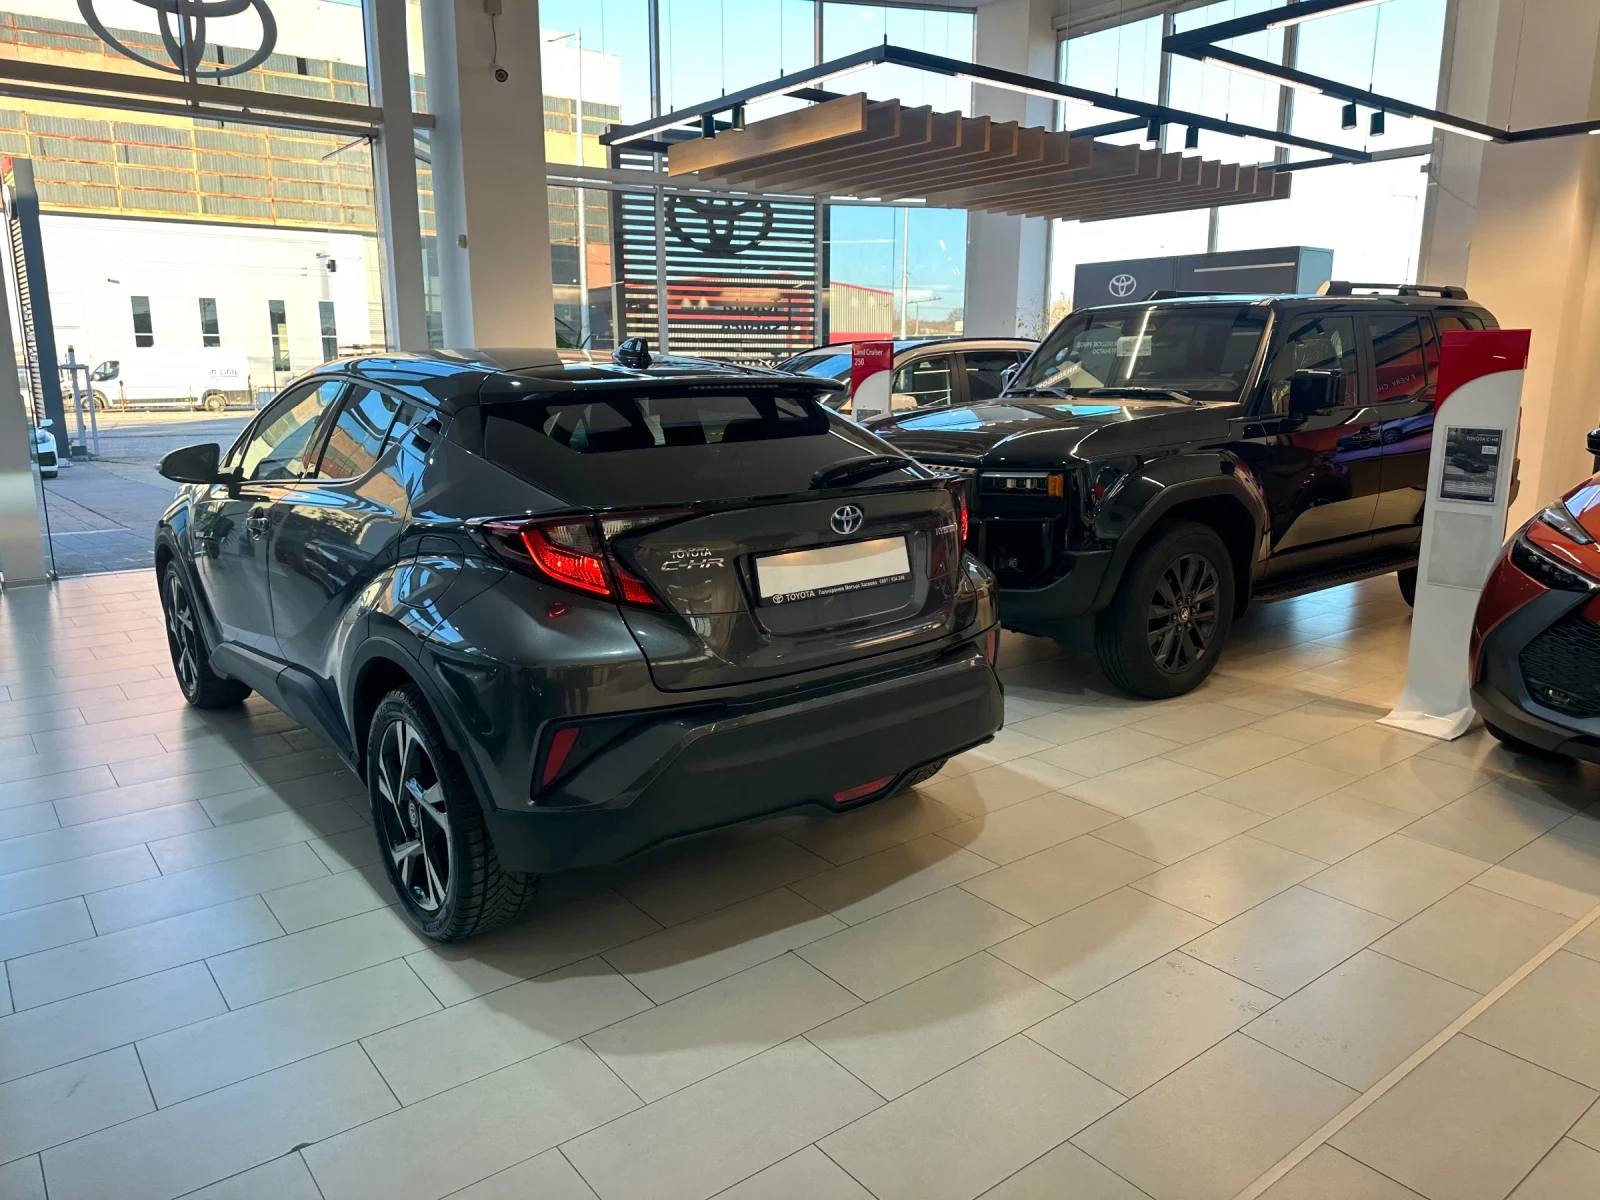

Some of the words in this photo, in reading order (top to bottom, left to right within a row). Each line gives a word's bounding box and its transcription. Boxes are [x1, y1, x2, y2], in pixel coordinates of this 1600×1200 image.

[854, 348, 866, 356] Land
[866, 348, 883, 356] Cruiser
[854, 357, 865, 366] 250
[670, 548, 712, 559] TOYOTA
[661, 558, 724, 571] C-HR
[786, 590, 815, 601] TOYOTA
